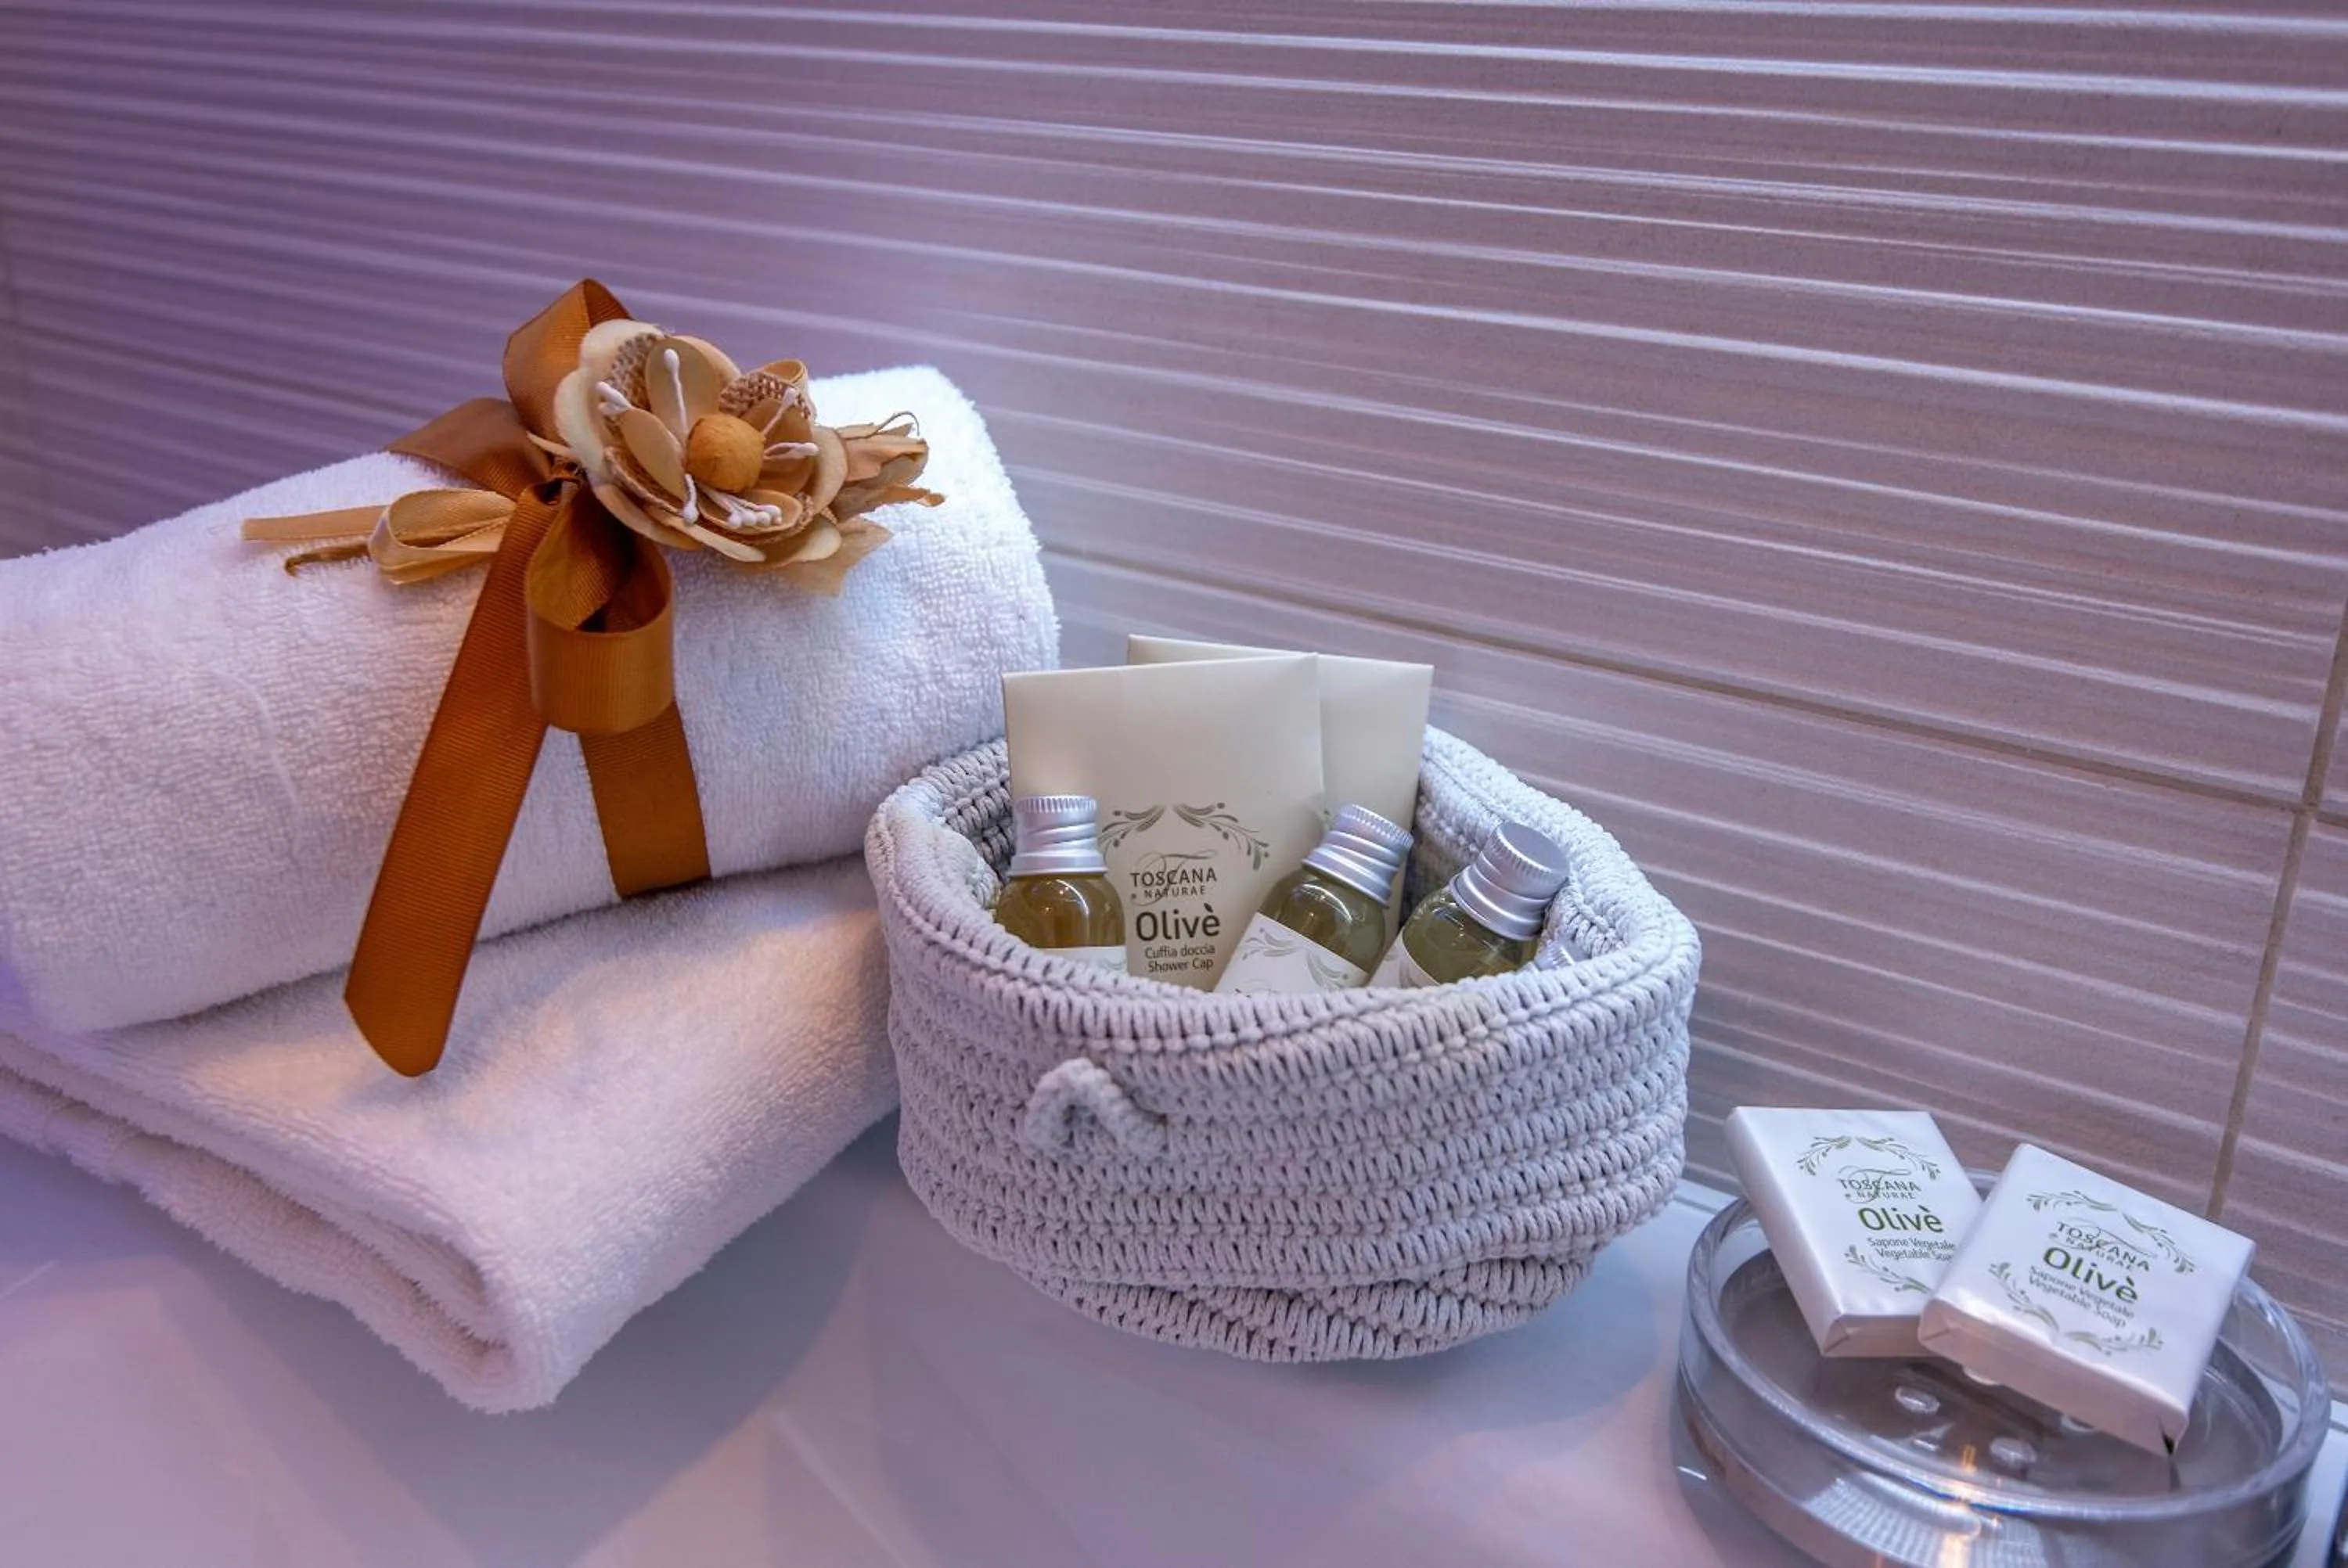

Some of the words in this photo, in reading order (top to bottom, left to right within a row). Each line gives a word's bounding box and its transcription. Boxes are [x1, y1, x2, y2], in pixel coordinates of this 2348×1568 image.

[1130, 867, 1217, 887] TOSCANA
[1144, 885, 1206, 899] NATURAE
[1136, 902, 1220, 941] Olivè
[1145, 946, 1178, 959] Cuffia
[1180, 944, 1215, 957] doccia
[1147, 959, 1189, 973] Shower
[1192, 957, 1214, 970] Cap
[1836, 1178, 1921, 1192] TOSCANA
[1857, 1204, 1944, 1233] Olivè
[1867, 1237, 1909, 1249] Sapone
[2057, 1221, 2150, 1271] TOSCANA
[1875, 1247, 1931, 1261] Vegetable
[2044, 1247, 2138, 1304] Olivè
[2029, 1265, 2076, 1290] Sapone
[2079, 1286, 2135, 1318] Vegetale
[2029, 1274, 2092, 1310] Vegetable
[2093, 1303, 2127, 1329] Soap
